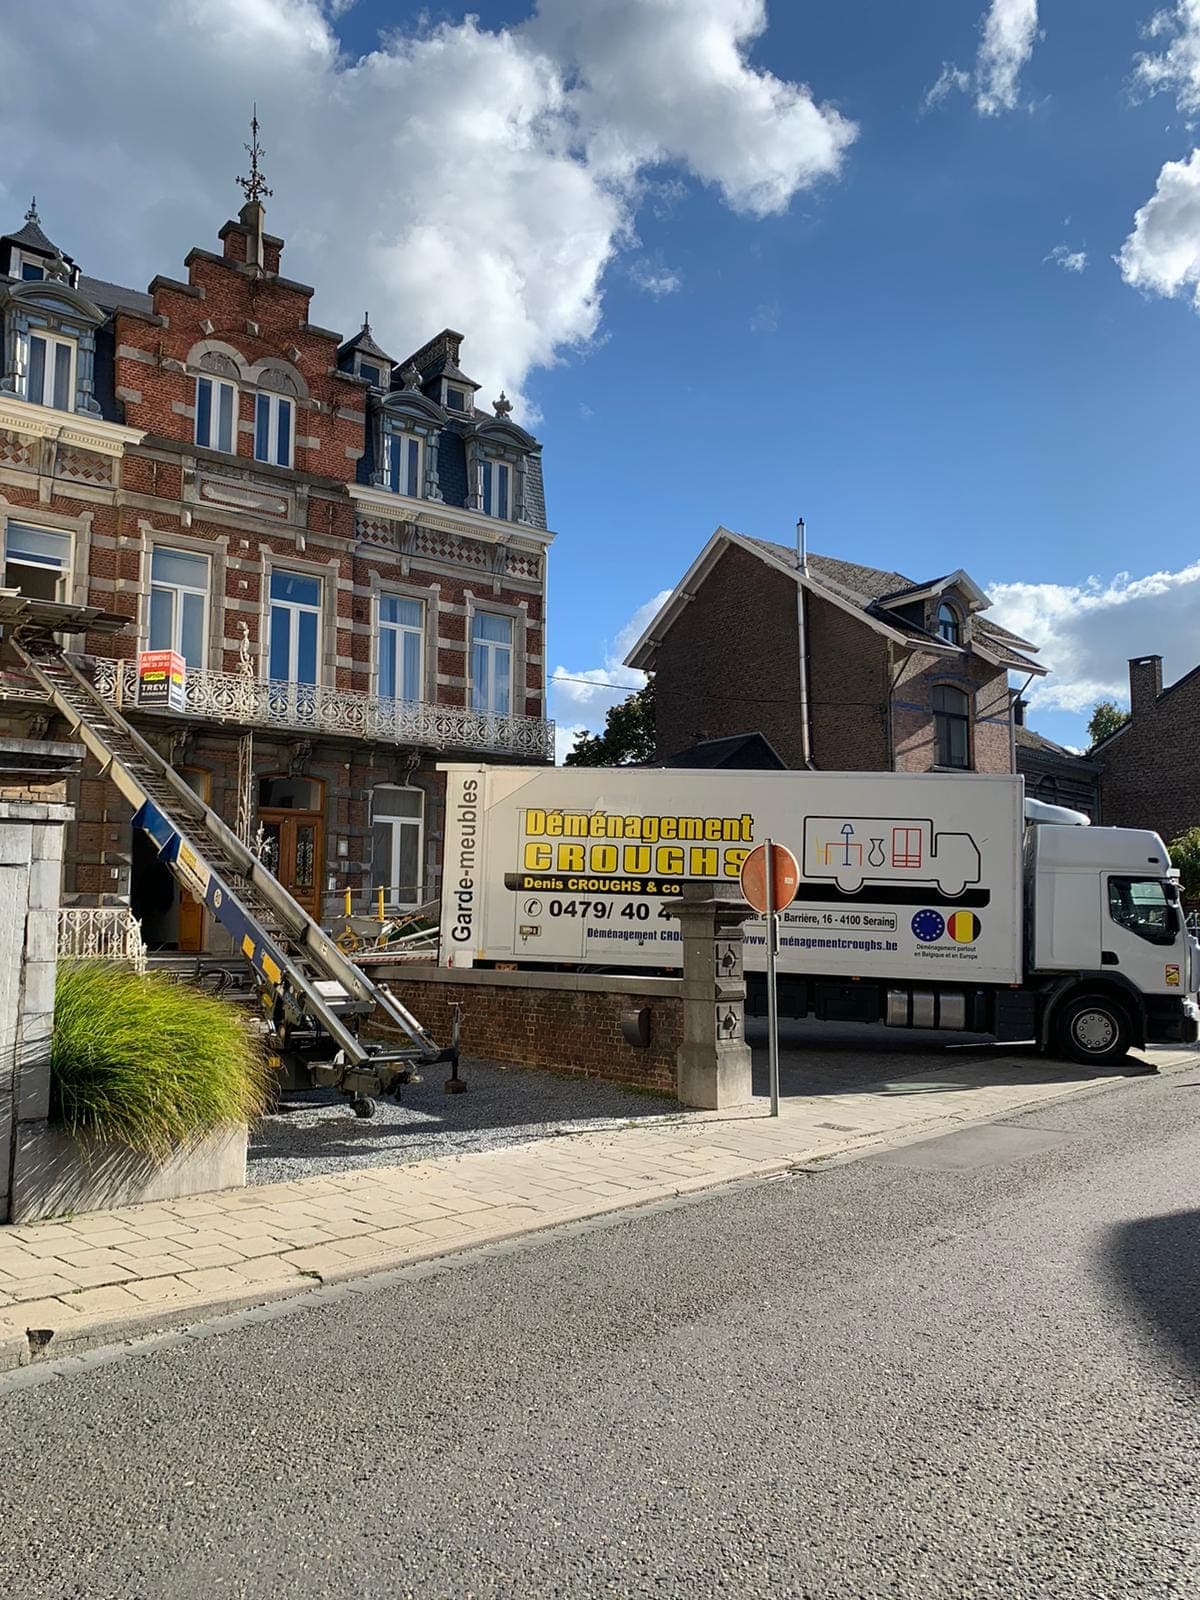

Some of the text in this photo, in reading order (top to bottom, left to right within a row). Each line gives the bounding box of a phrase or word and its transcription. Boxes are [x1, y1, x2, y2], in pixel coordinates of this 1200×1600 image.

[526, 808, 754, 843] Déménagement
[452, 780, 478, 942] Garde-meubles
[524, 842, 751, 878] CROUGHS
[524, 877, 563, 889] Denis
[568, 879, 641, 892] CROUGHS
[646, 882, 657, 893] &
[549, 900, 614, 919] 0479/
[621, 902, 650, 920] 40
[784, 912, 820, 925] Barrière,
[822, 914, 833, 924] 16
[840, 915, 860, 925] 4100
[863, 916, 895, 929] Seraing
[587, 928, 657, 941] Déménagement
[743, 936, 898, 952] www.ménagementcroughs.be
[916, 943, 957, 952] Déménagement
[921, 951, 944, 959] Belgique
